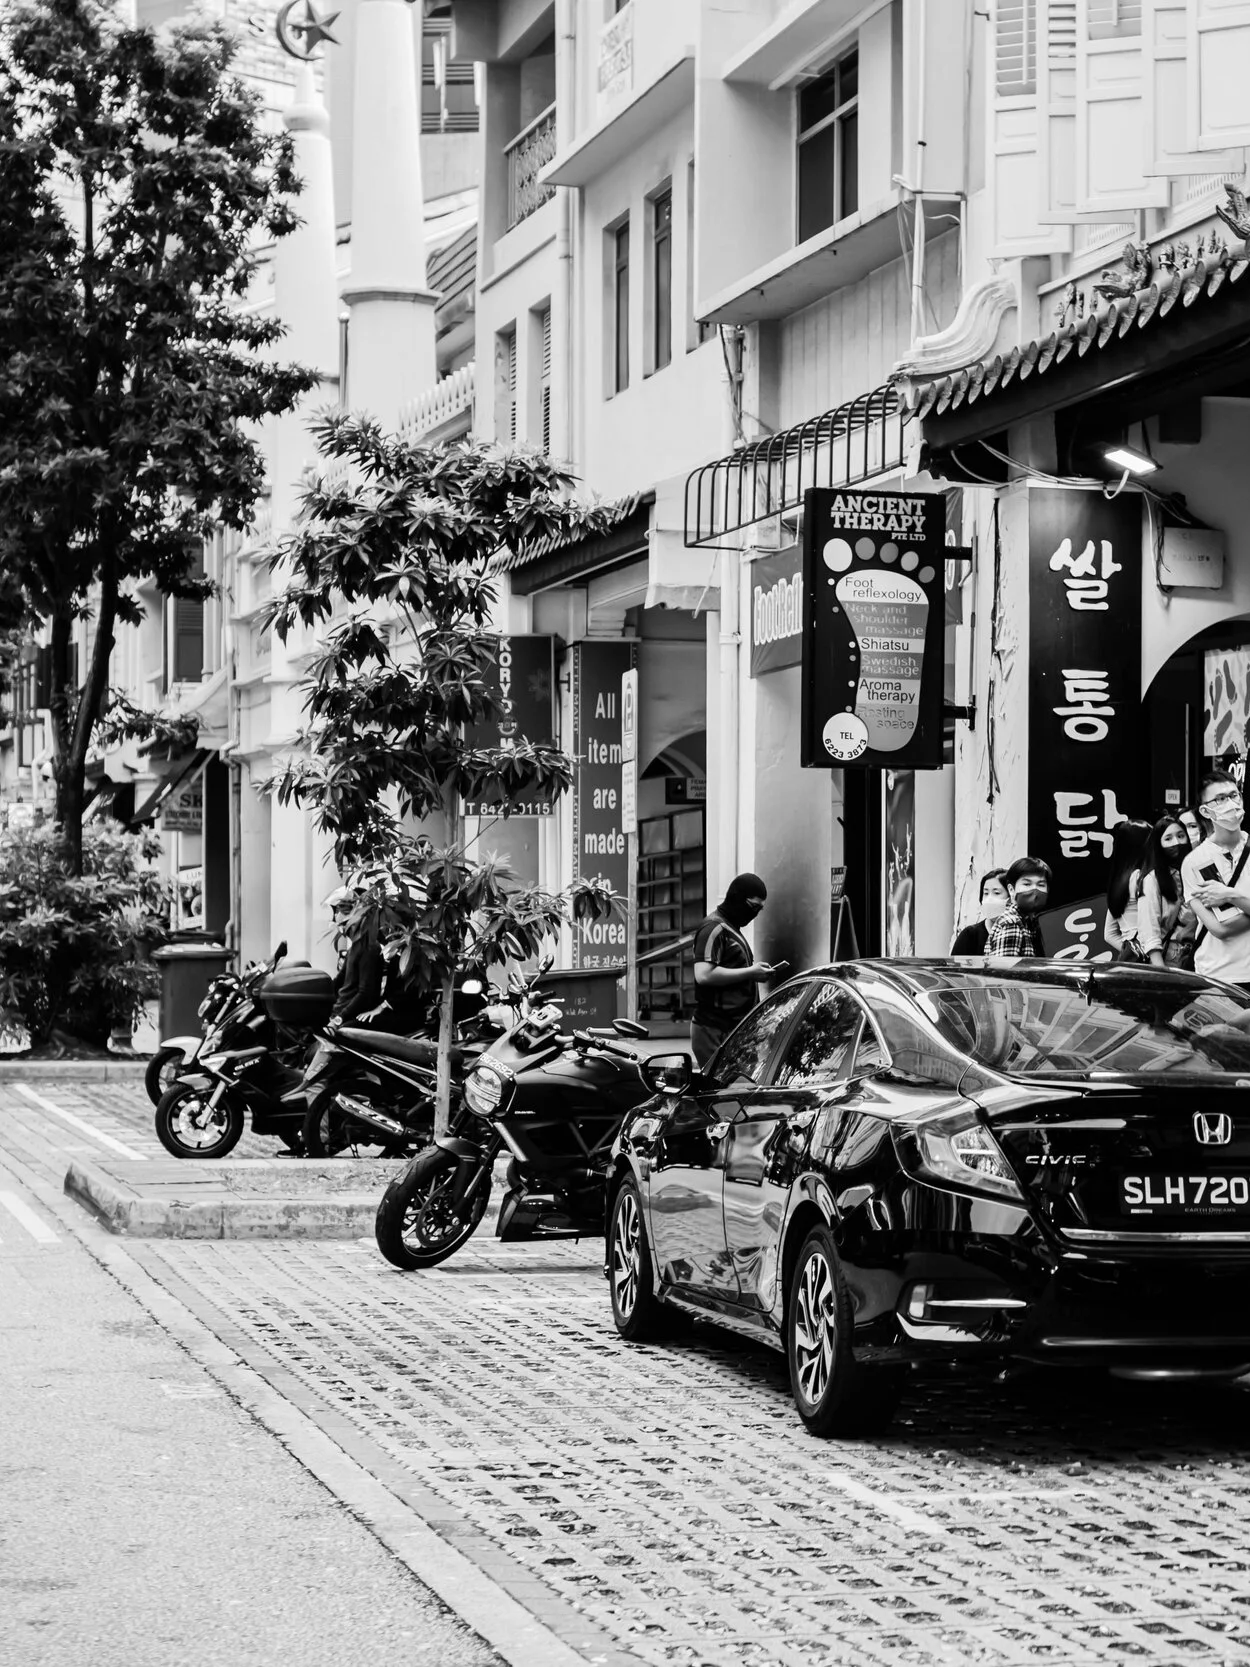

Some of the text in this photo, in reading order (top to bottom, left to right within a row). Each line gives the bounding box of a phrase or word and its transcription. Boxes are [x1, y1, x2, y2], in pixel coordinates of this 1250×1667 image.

[831, 495, 926, 515] ANCIENT
[830, 511, 926, 533] THERAPY
[891, 532, 926, 541] PTE LTD
[845, 577, 874, 588] Foot
[853, 589, 922, 602] reflexology
[846, 604, 907, 615] Neck and
[853, 614, 909, 624] shoulder
[865, 625, 924, 637] massage
[861, 638, 909, 651] Shiatsu
[862, 655, 916, 666] Swedish
[498, 637, 512, 714] KORYO
[862, 665, 919, 677] massage
[859, 679, 901, 691] Aroma
[867, 690, 915, 703] therapy
[595, 692, 616, 719] All
[840, 732, 854, 740] TEL
[588, 737, 622, 764] item
[824, 738, 867, 759] 6223 3873
[593, 787, 617, 810] are
[467, 803, 475, 814] T
[585, 832, 625, 855] made
[583, 917, 626, 945] Korea
[1025, 1154, 1087, 1165] CIVIC
